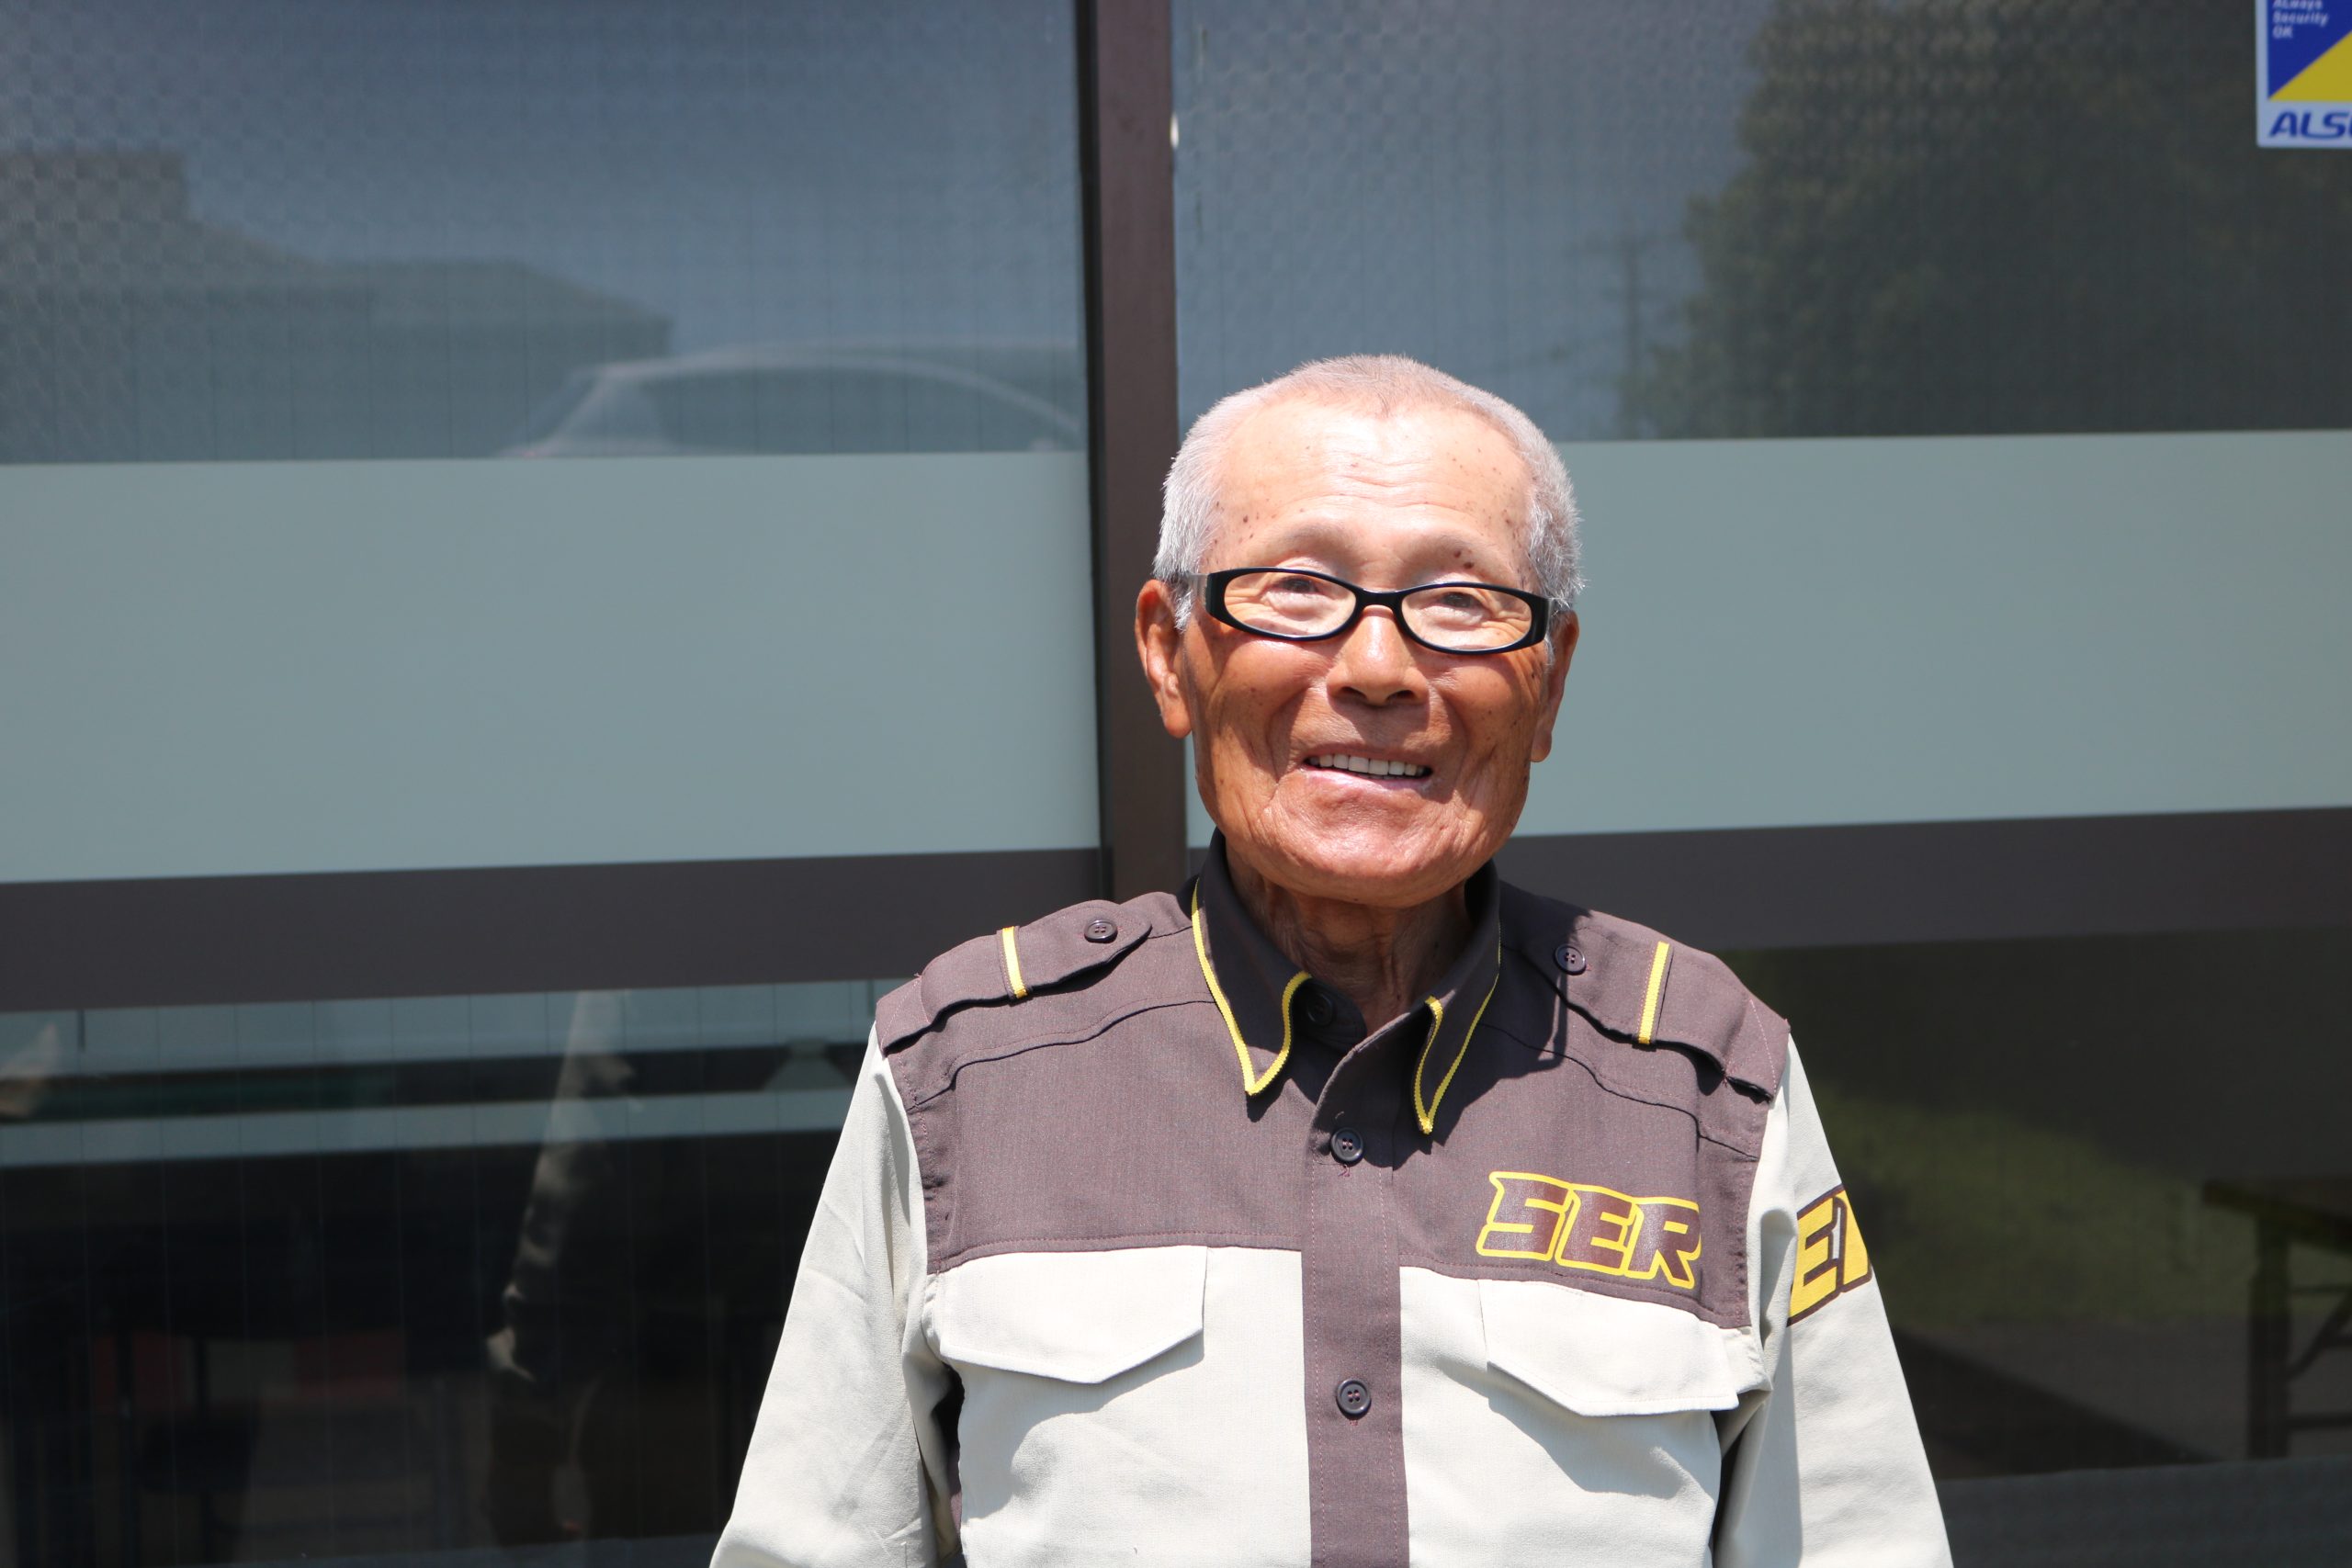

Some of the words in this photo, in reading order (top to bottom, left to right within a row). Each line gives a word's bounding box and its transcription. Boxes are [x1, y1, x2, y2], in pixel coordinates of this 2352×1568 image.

[2272, 10, 2329, 27] Security
[2272, 25, 2293, 39] OK
[2269, 109, 2352, 140] ALS
[1476, 1170, 1702, 1290] SER
